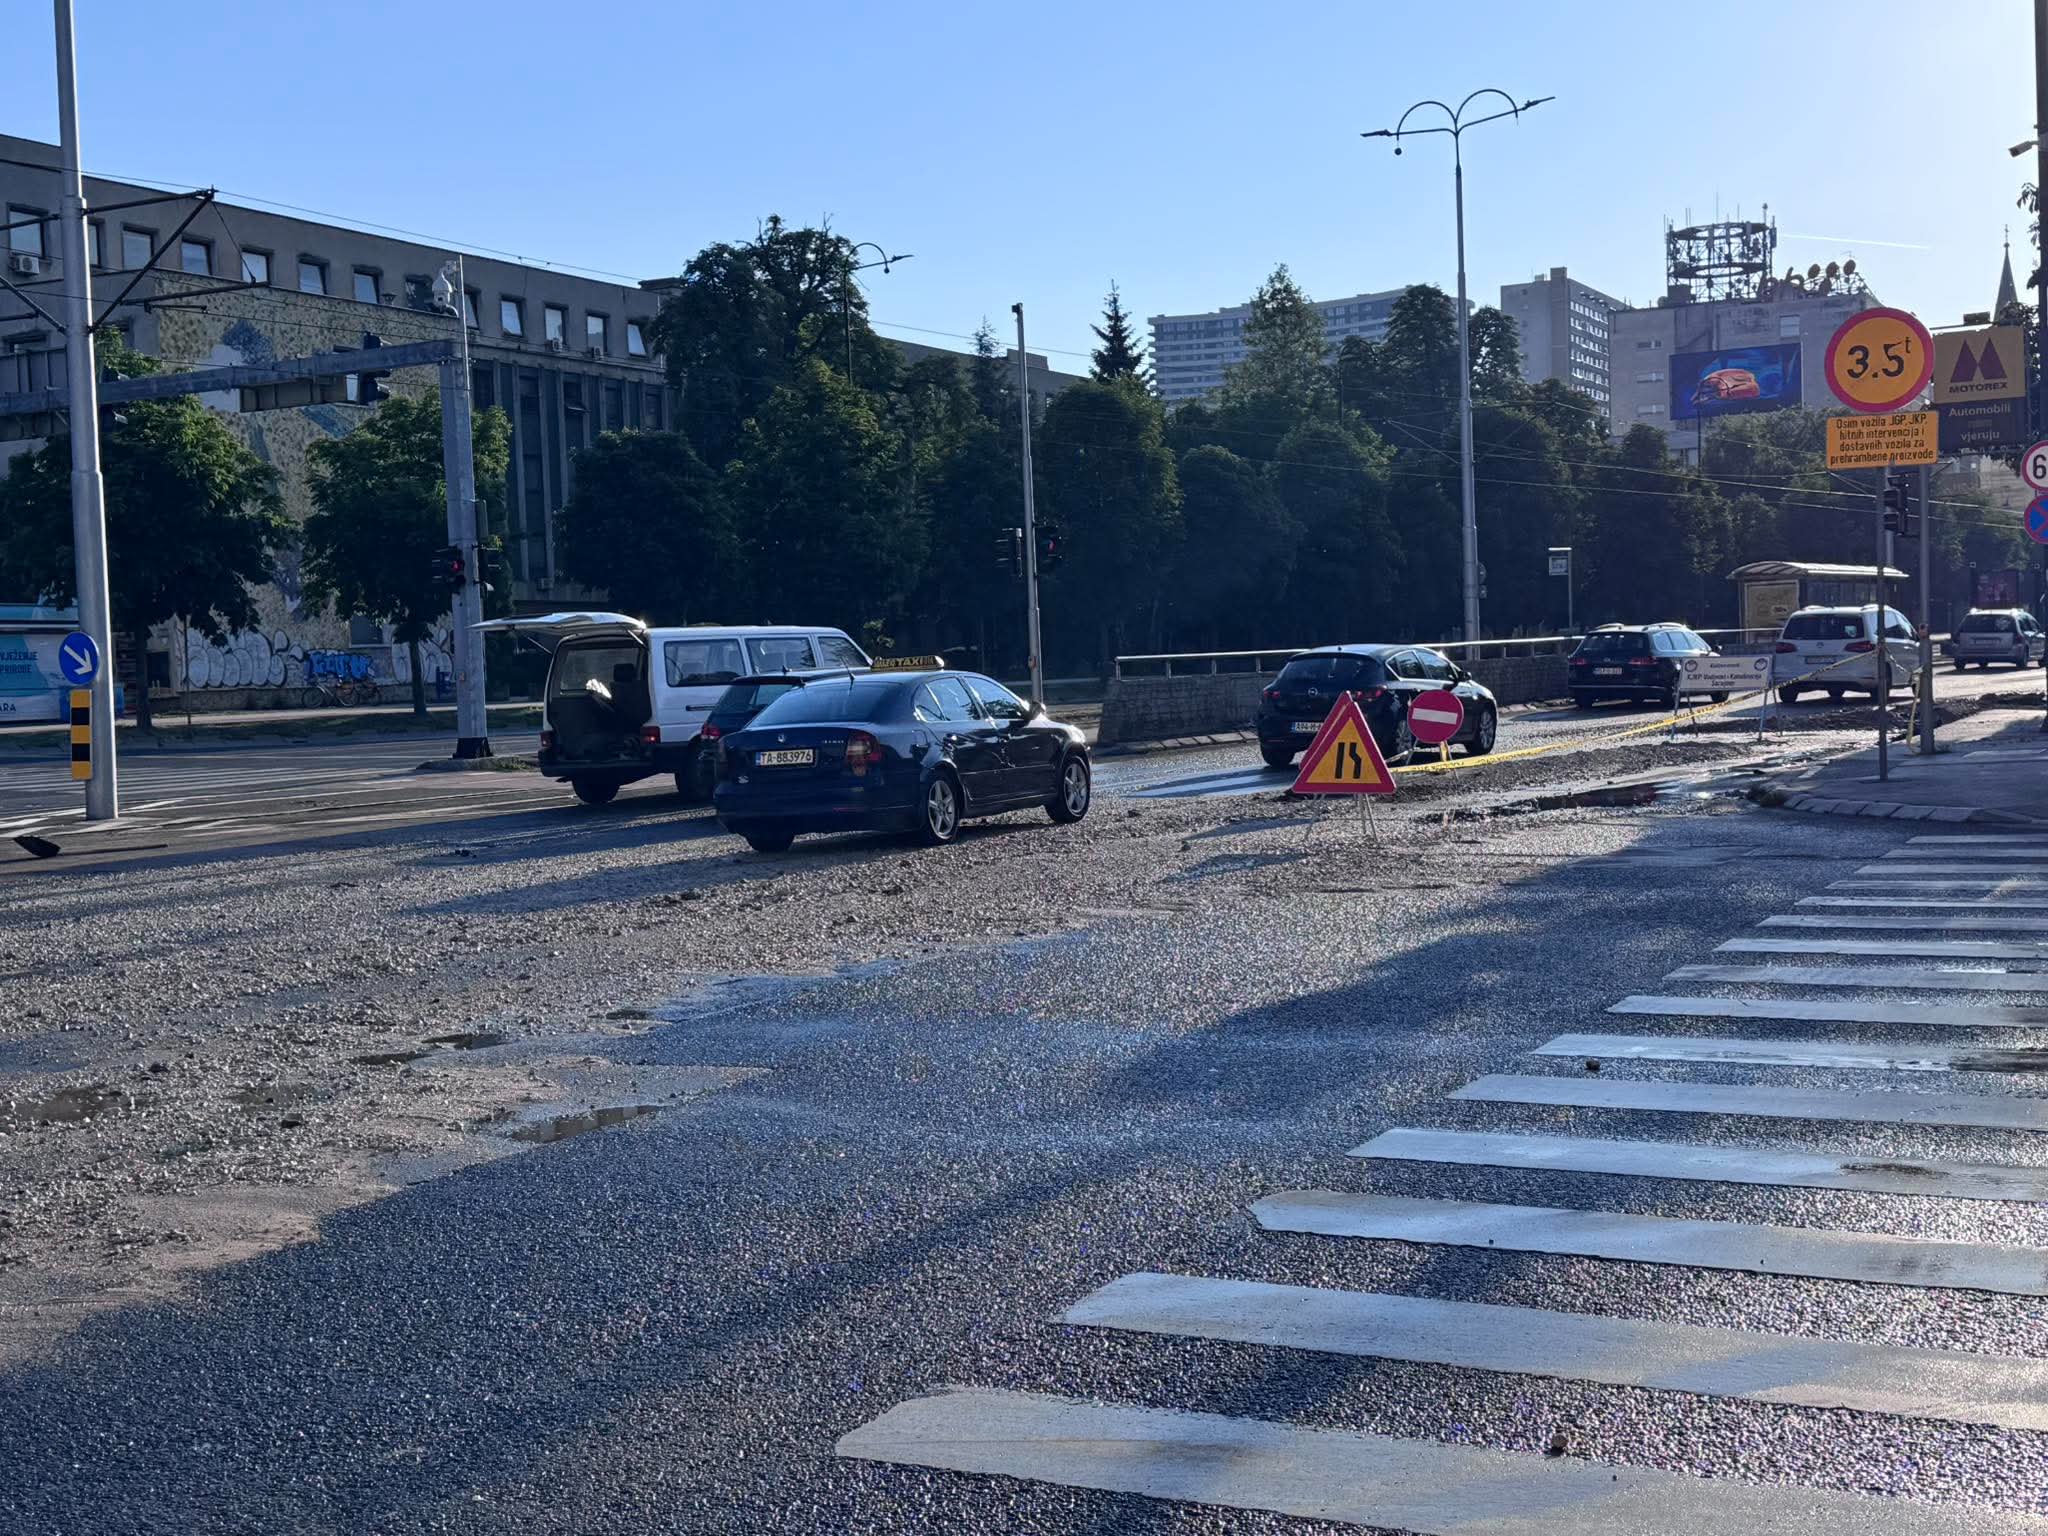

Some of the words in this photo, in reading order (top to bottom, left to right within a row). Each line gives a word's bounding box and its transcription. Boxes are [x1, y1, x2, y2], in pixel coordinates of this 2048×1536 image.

[1846, 344, 1904, 379] 3.5
[1904, 336, 1912, 354] t
[1948, 382, 2008, 393] MOTOREX
[1949, 402, 2011, 417] Automobili
[1836, 418, 1858, 429] Osim
[1861, 417, 1886, 427] vozila
[1839, 429, 1864, 440] hitnih
[1866, 427, 1919, 439] intervencija
[1921, 428, 1925, 436] i
[1960, 430, 2000, 442] vjeruju
[1839, 439, 1883, 452] dostavnih
[1886, 439, 1911, 449] vozila
[1913, 440, 1925, 448] za
[1830, 452, 1888, 466] prehrambene
[1890, 449, 1934, 463] proizvode
[761, 750, 812, 765] TA-883976
